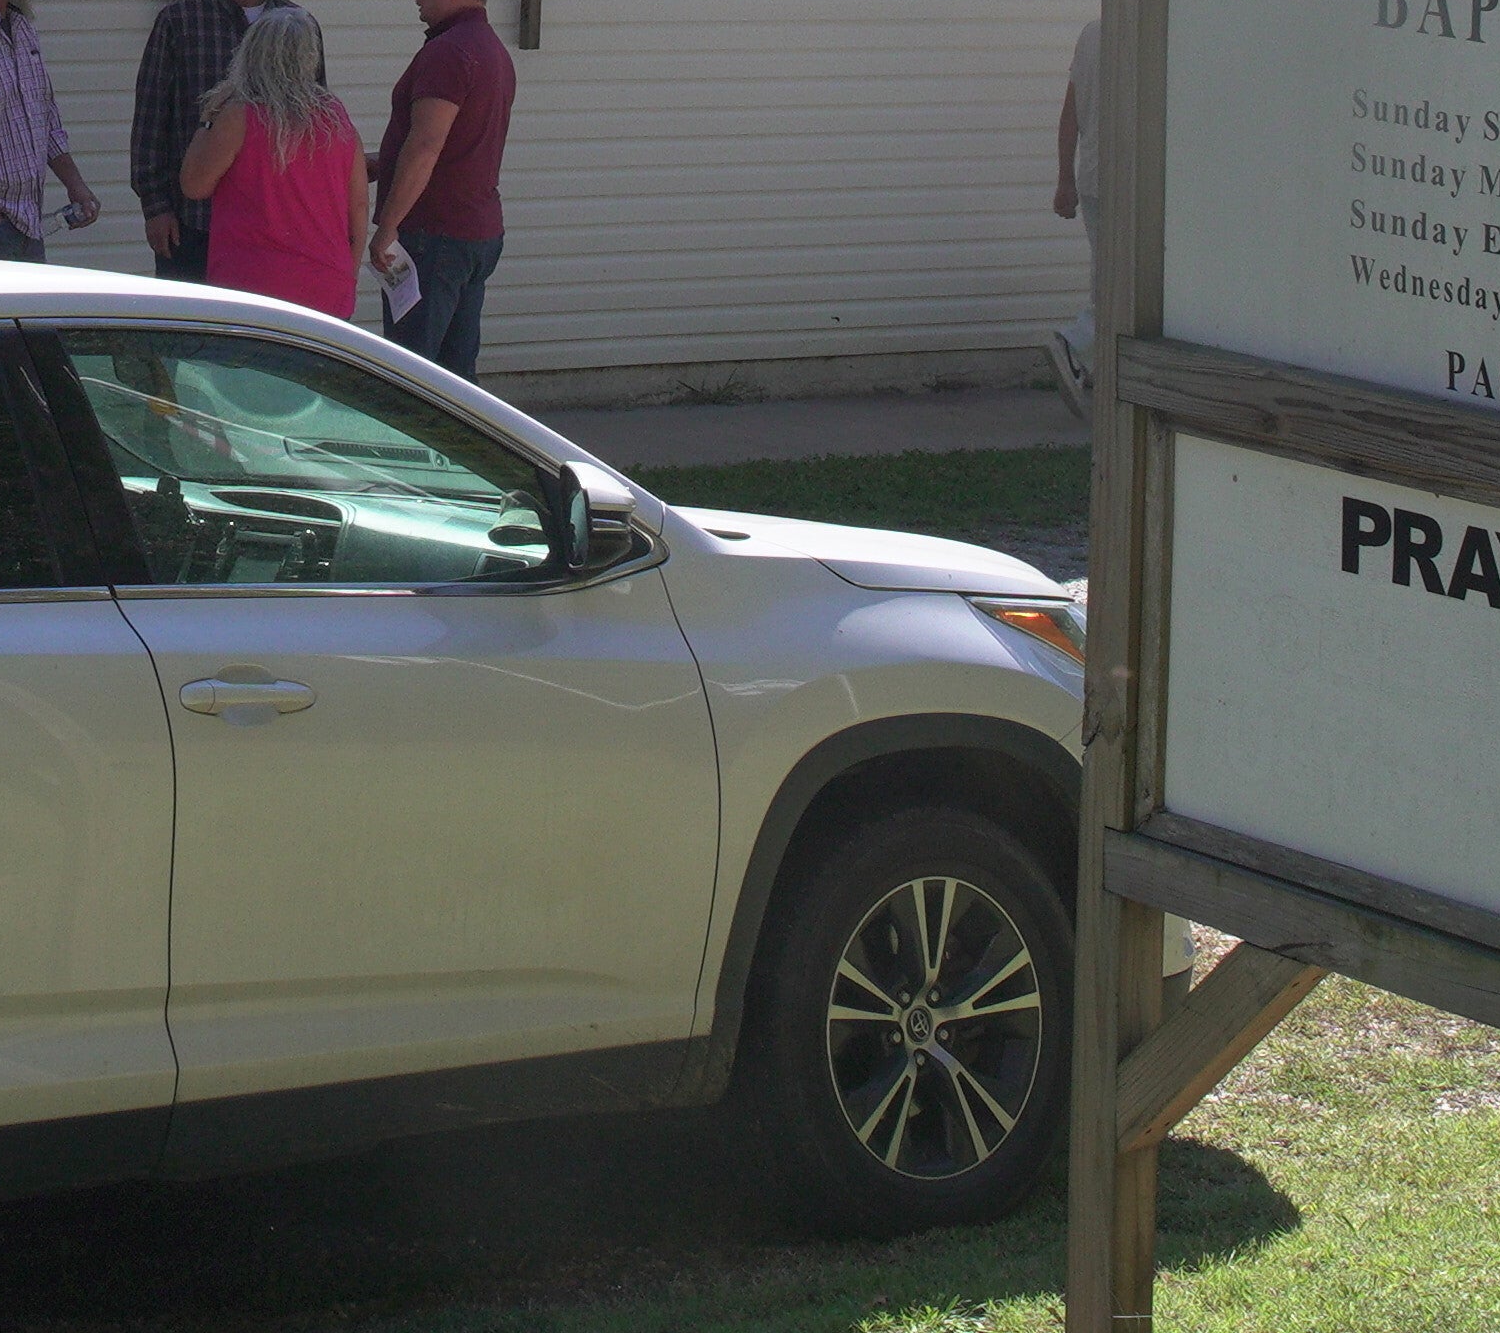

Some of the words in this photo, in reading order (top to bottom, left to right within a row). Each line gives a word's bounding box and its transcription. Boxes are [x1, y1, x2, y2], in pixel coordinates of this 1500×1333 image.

[1352, 89, 1471, 144] Sunday
[1351, 142, 1466, 198] Sunday
[1350, 199, 1468, 256] Sunday
